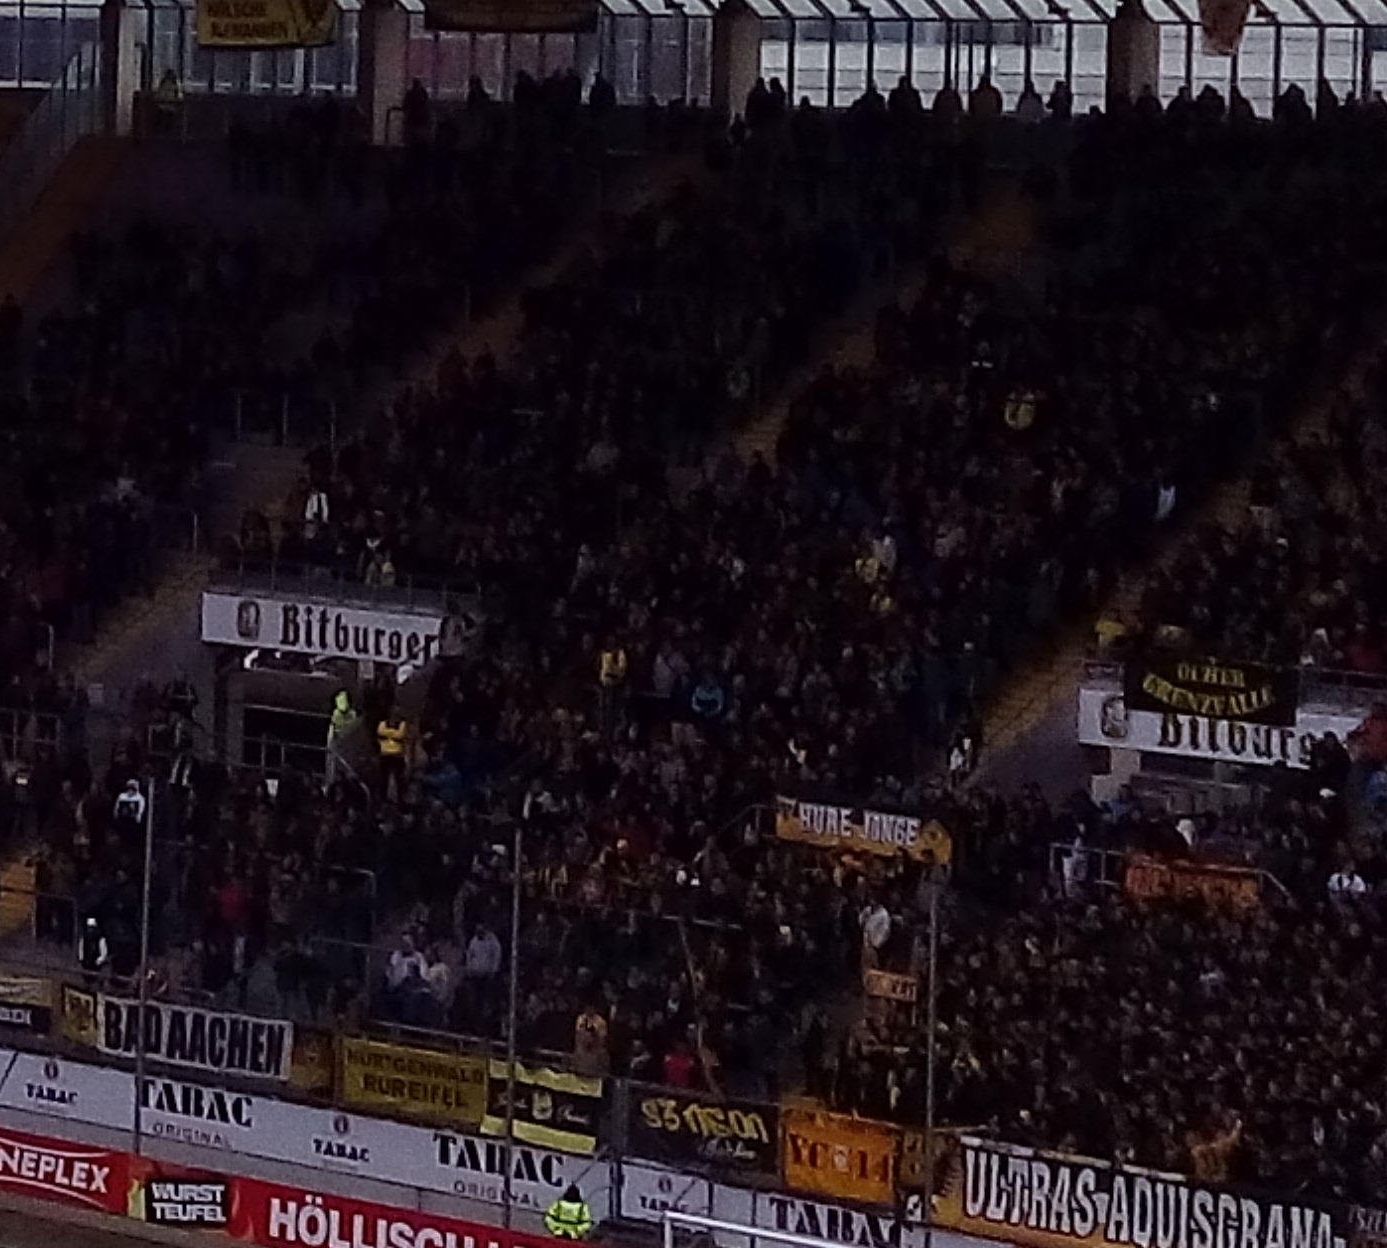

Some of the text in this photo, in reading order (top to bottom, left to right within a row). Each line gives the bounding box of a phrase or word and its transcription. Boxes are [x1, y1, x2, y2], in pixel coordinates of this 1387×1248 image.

[279, 603, 439, 659] Bitburger
[104, 1002, 285, 1077] BAD AACHEN
[26, 1082, 80, 1104] TABAC
[139, 1079, 254, 1129] TABAC
[312, 1138, 371, 1163] TABAC
[150, 1181, 226, 1203] WURST
[965, 1149, 1097, 1237] ULTRAS
[151, 1201, 227, 1223] TEUFEL
